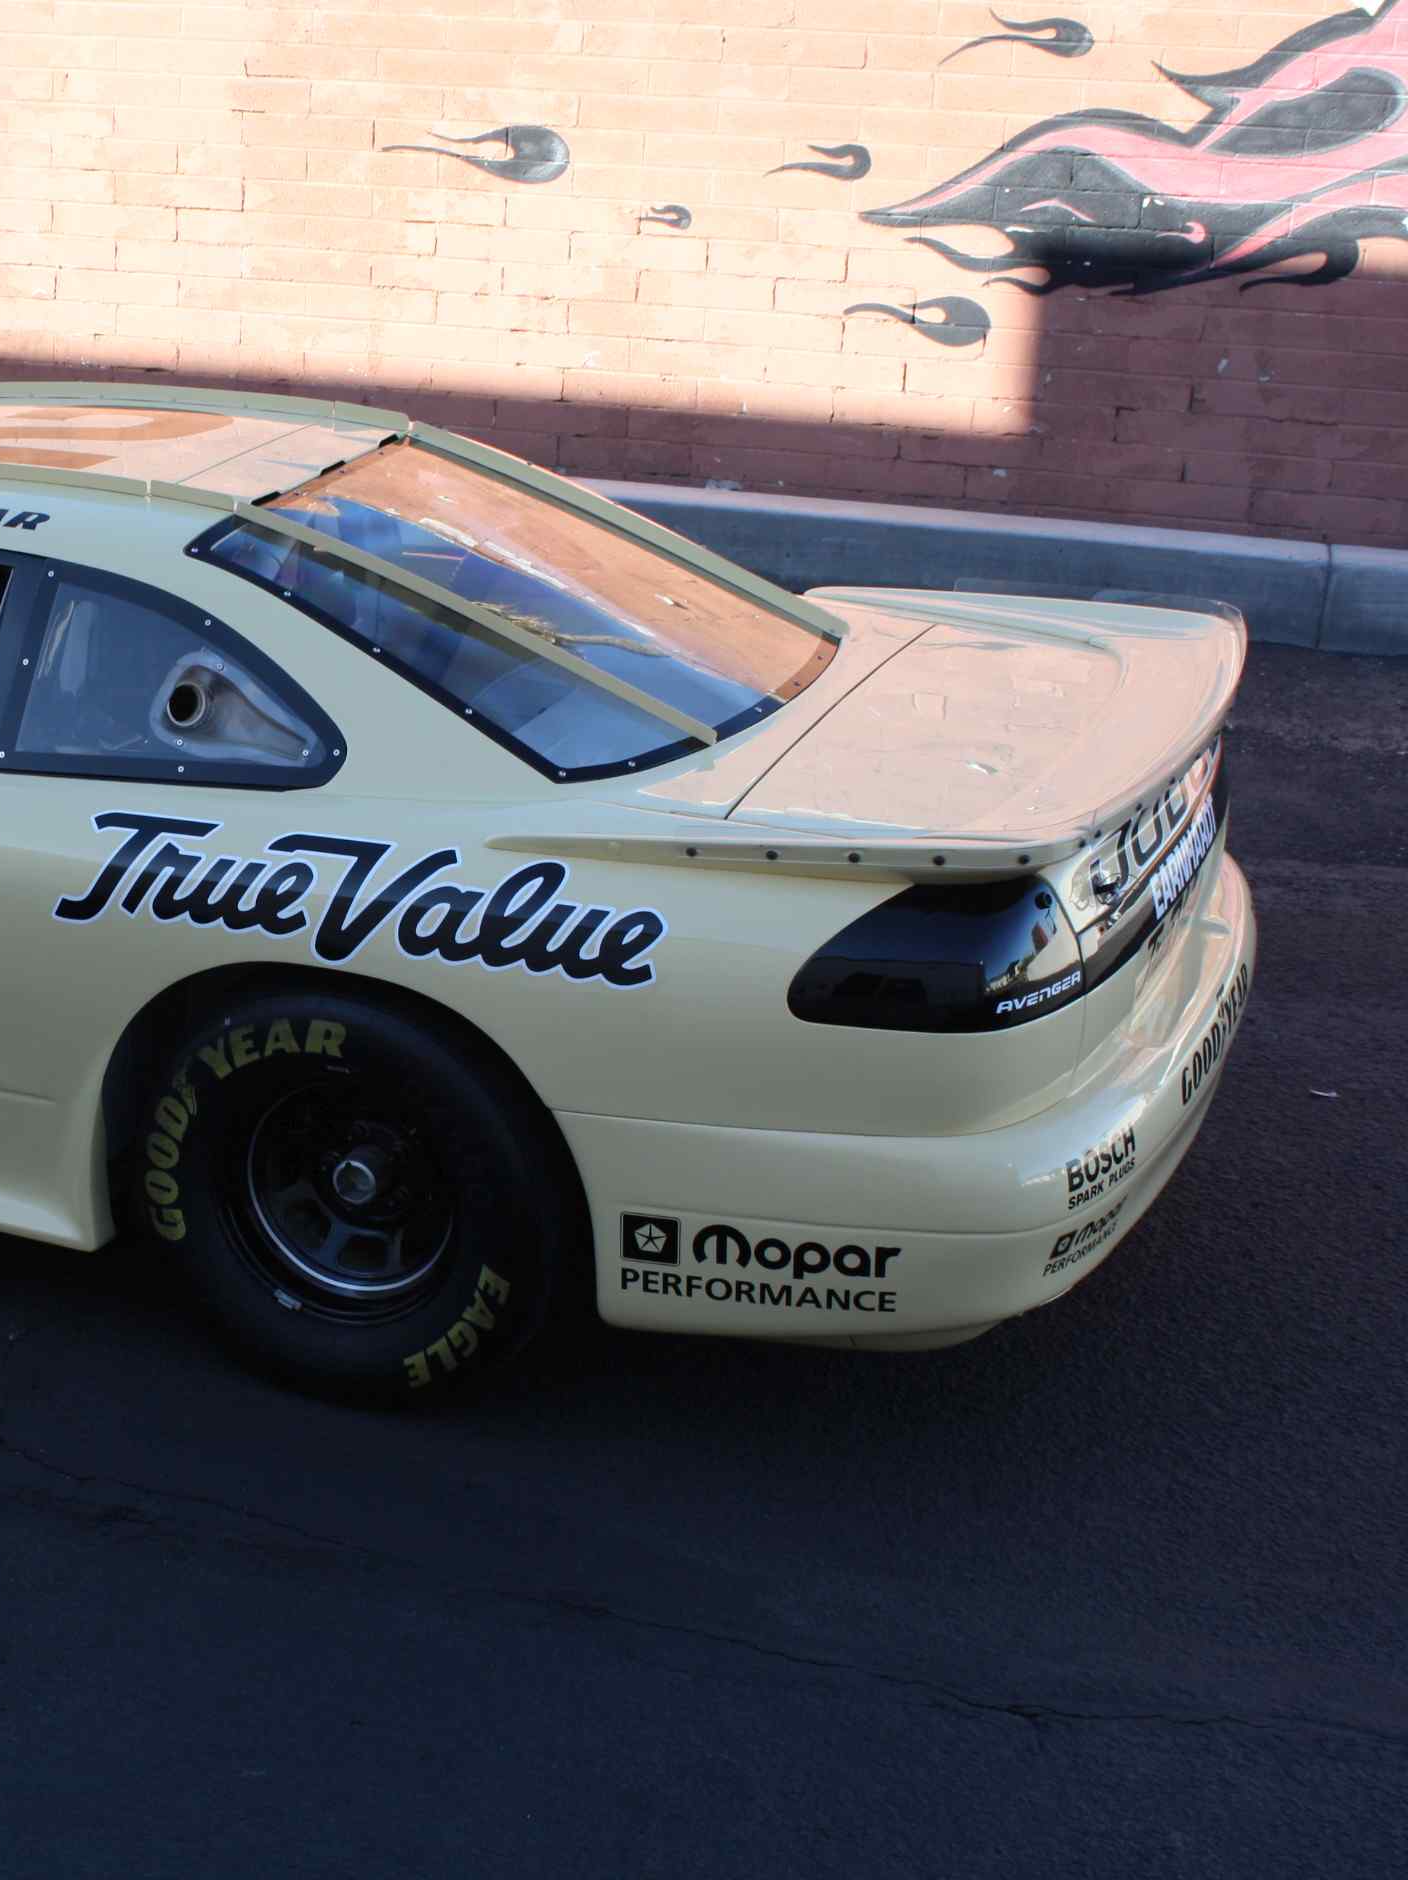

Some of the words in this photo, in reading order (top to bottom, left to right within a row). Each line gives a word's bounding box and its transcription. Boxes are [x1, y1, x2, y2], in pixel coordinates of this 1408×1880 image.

[1150, 791, 1217, 921] EARNHARDT
[53, 810, 318, 937] True
[267, 832, 665, 989] Value
[996, 970, 1082, 1015] AVENGER
[1065, 1125, 1136, 1193] BOSCH
[1067, 1179, 1105, 1211] SPARK
[1108, 1157, 1136, 1187] PLUGS
[620, 1267, 897, 1313] PERFORMANCE
[403, 1264, 511, 1388] EAGLE
